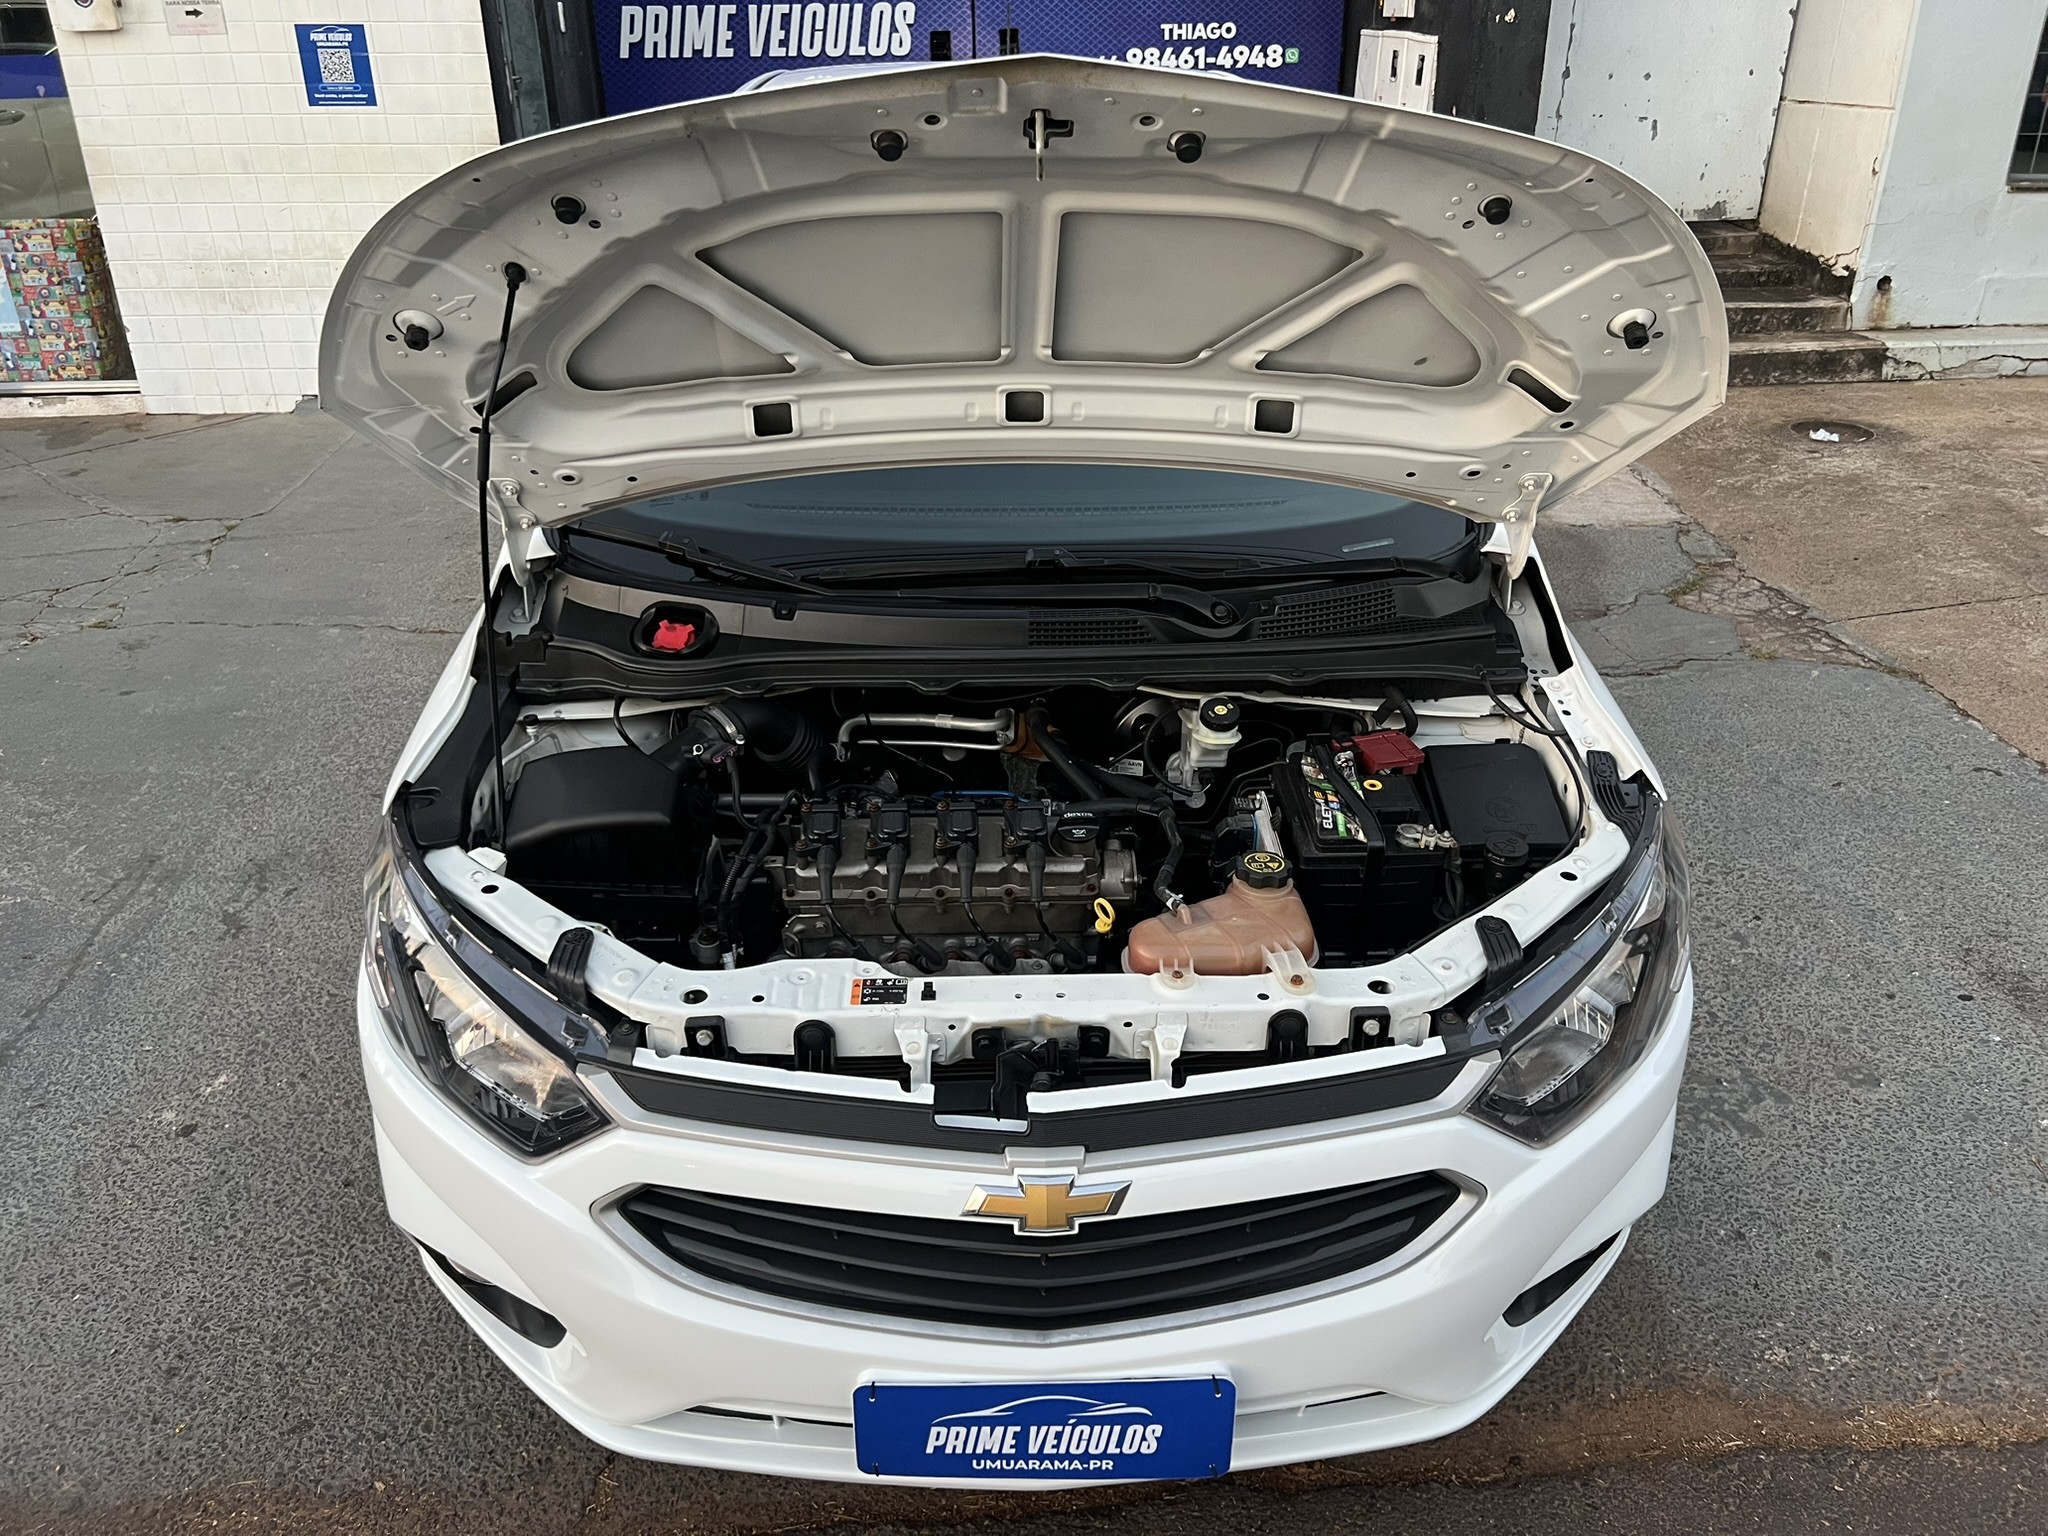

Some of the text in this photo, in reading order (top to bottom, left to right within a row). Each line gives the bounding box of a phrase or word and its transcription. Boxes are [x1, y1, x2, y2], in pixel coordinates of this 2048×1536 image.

[619, 5, 737, 59] PRIME
[1160, 22, 1237, 41] THIAGO
[1125, 44, 1284, 70] 98461-4948
[925, 1418, 1163, 1455] PRIME VEÍCULOS
[972, 1459, 1114, 1471] UMUARAMA-PR
